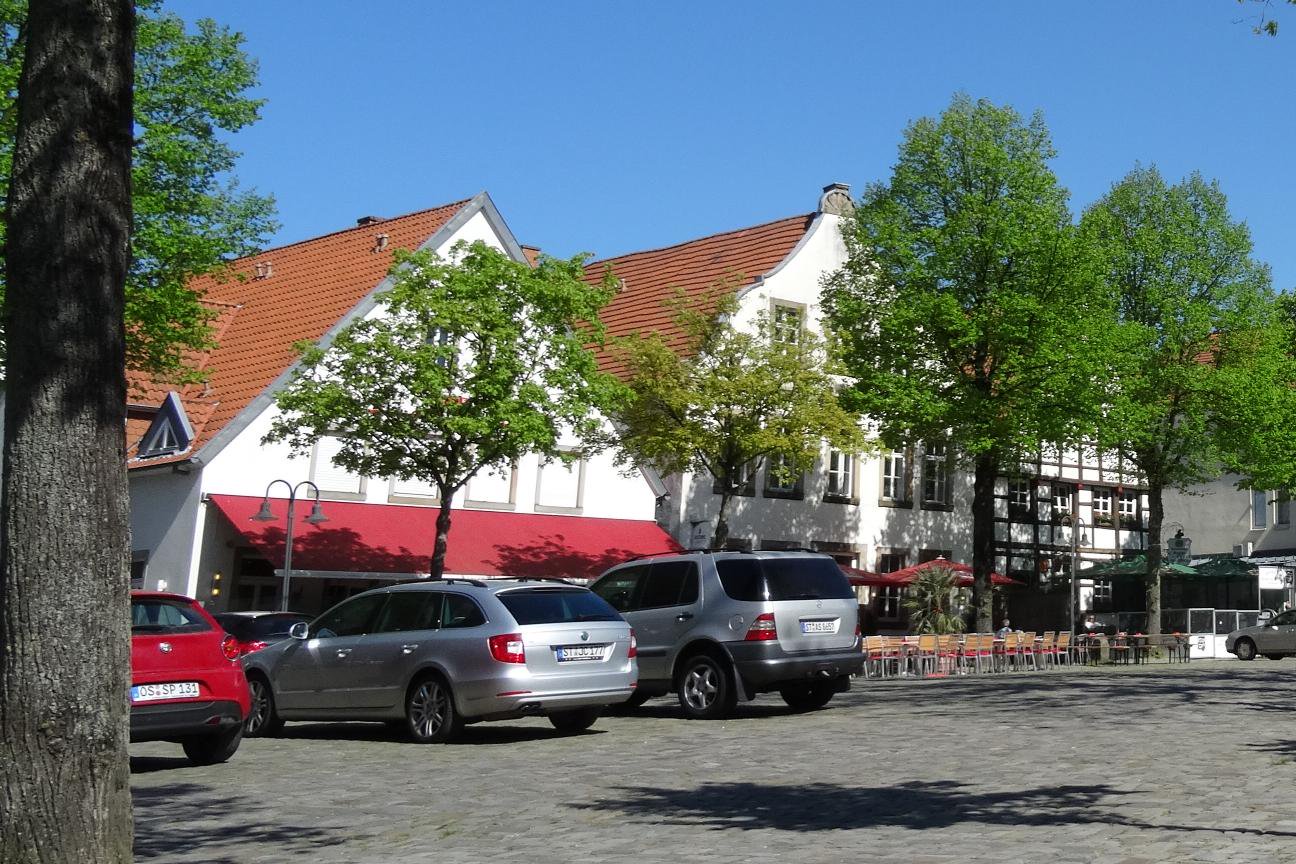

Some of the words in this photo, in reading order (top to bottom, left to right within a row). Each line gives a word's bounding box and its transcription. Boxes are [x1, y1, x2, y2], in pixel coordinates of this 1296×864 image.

[139, 685, 155, 697] OS
[162, 684, 176, 695] SP
[178, 683, 198, 694] 131
